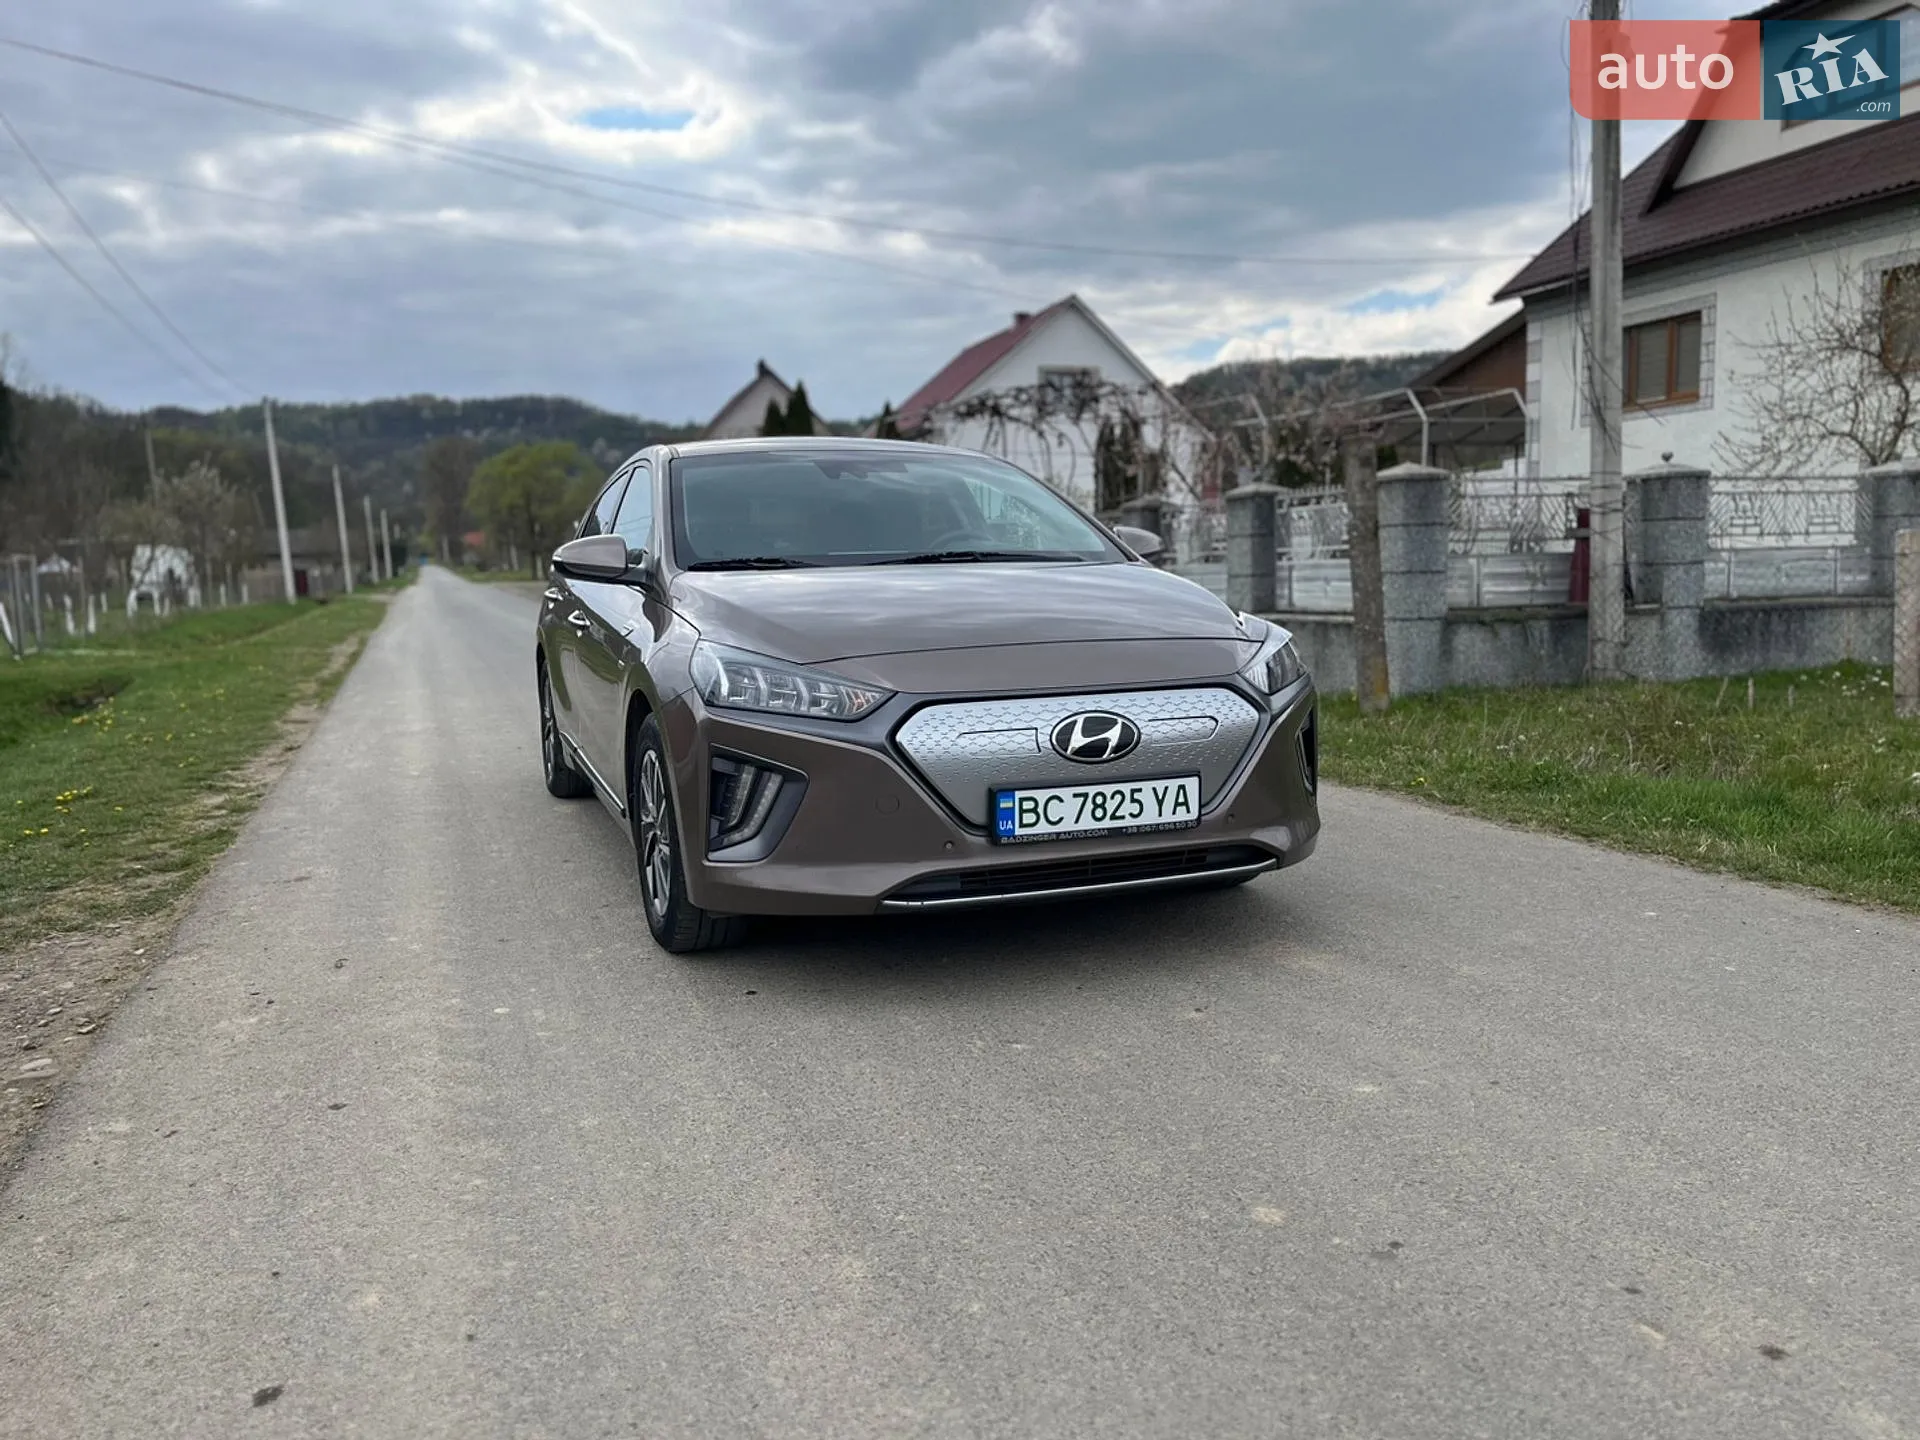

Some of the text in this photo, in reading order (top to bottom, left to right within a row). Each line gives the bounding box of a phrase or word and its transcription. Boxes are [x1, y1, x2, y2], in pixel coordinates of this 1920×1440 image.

[1018, 783, 1191, 828] BC 7825 YA
[1000, 820, 1013, 830] UA
